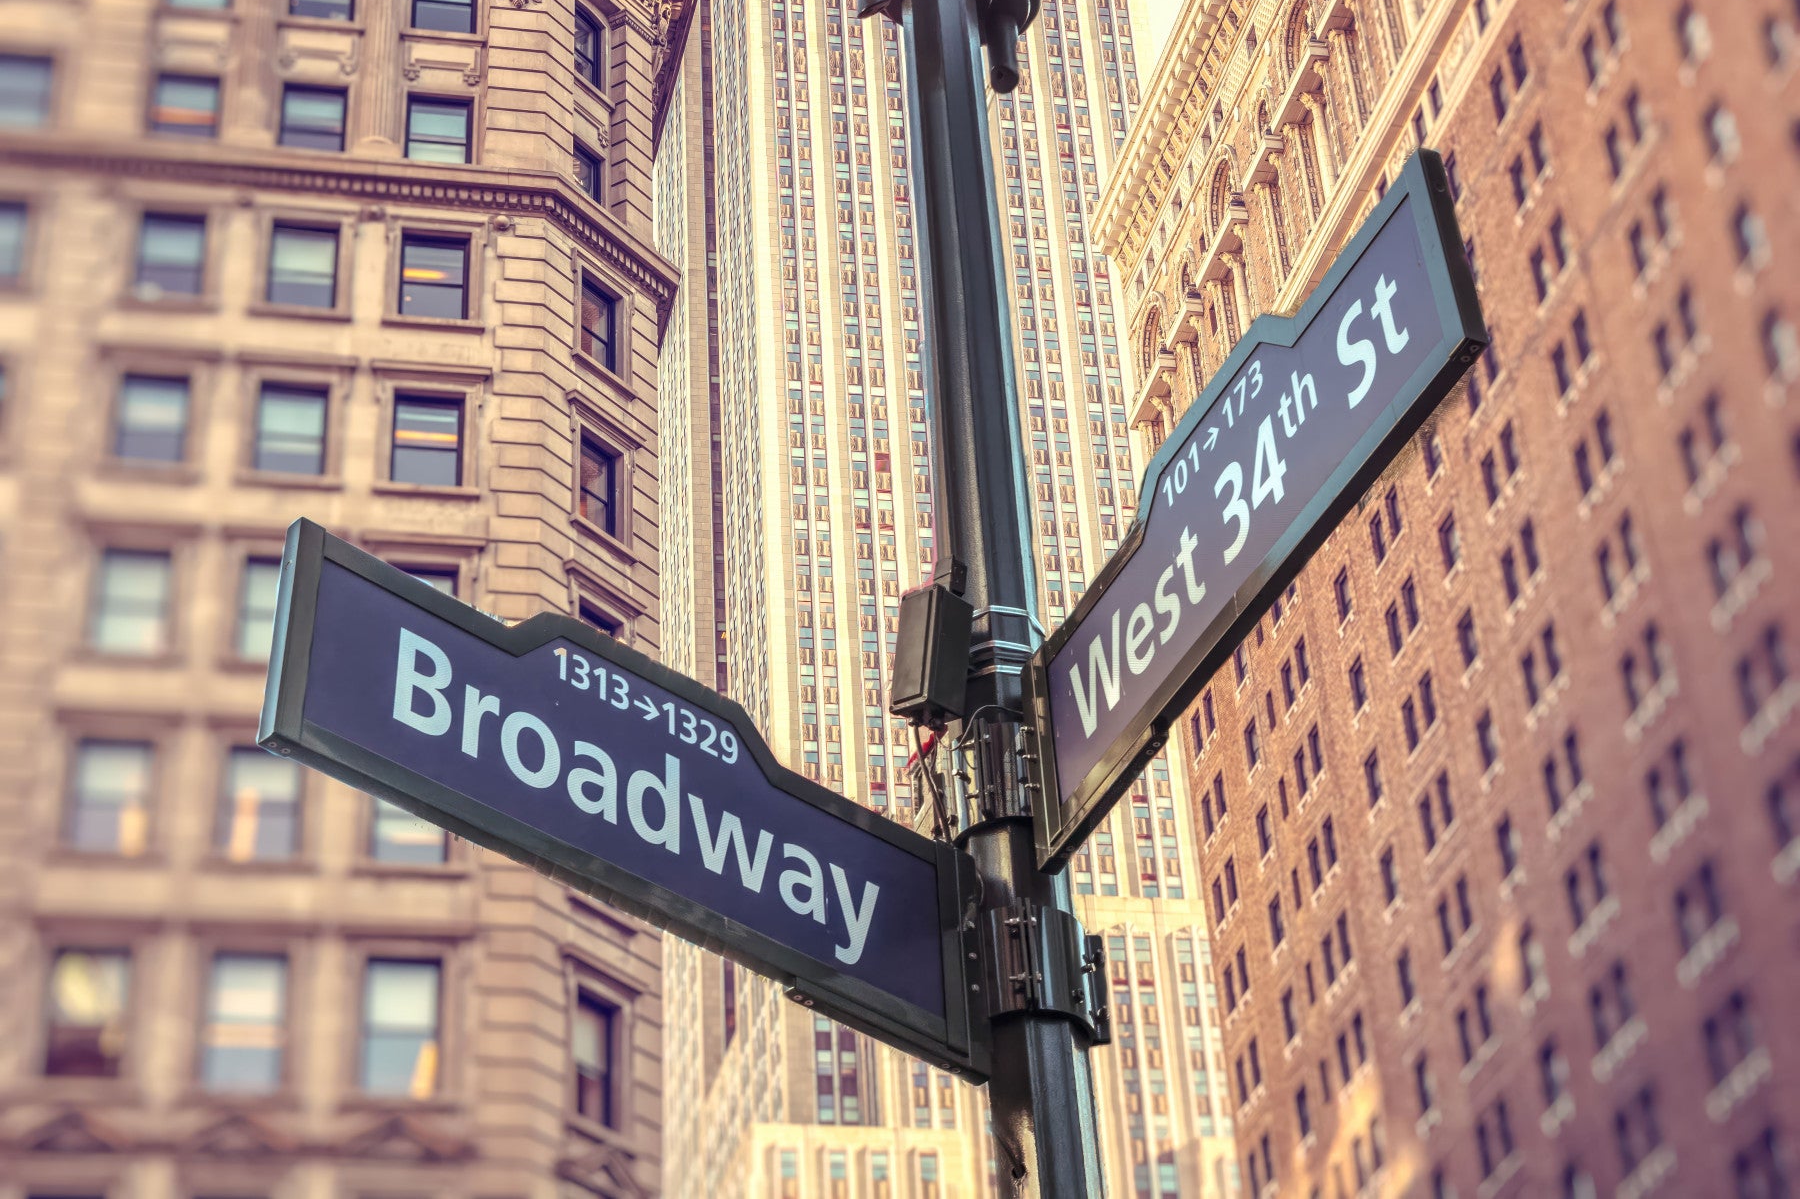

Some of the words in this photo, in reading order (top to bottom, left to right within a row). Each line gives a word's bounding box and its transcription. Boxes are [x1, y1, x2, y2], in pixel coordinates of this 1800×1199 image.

[1068, 525, 1207, 740] West
[1213, 371, 1318, 567] 34th
[1335, 273, 1409, 410] St
[1162, 448, 1201, 507] 101
[1221, 359, 1264, 429] 173
[392, 626, 881, 965] Broadway
